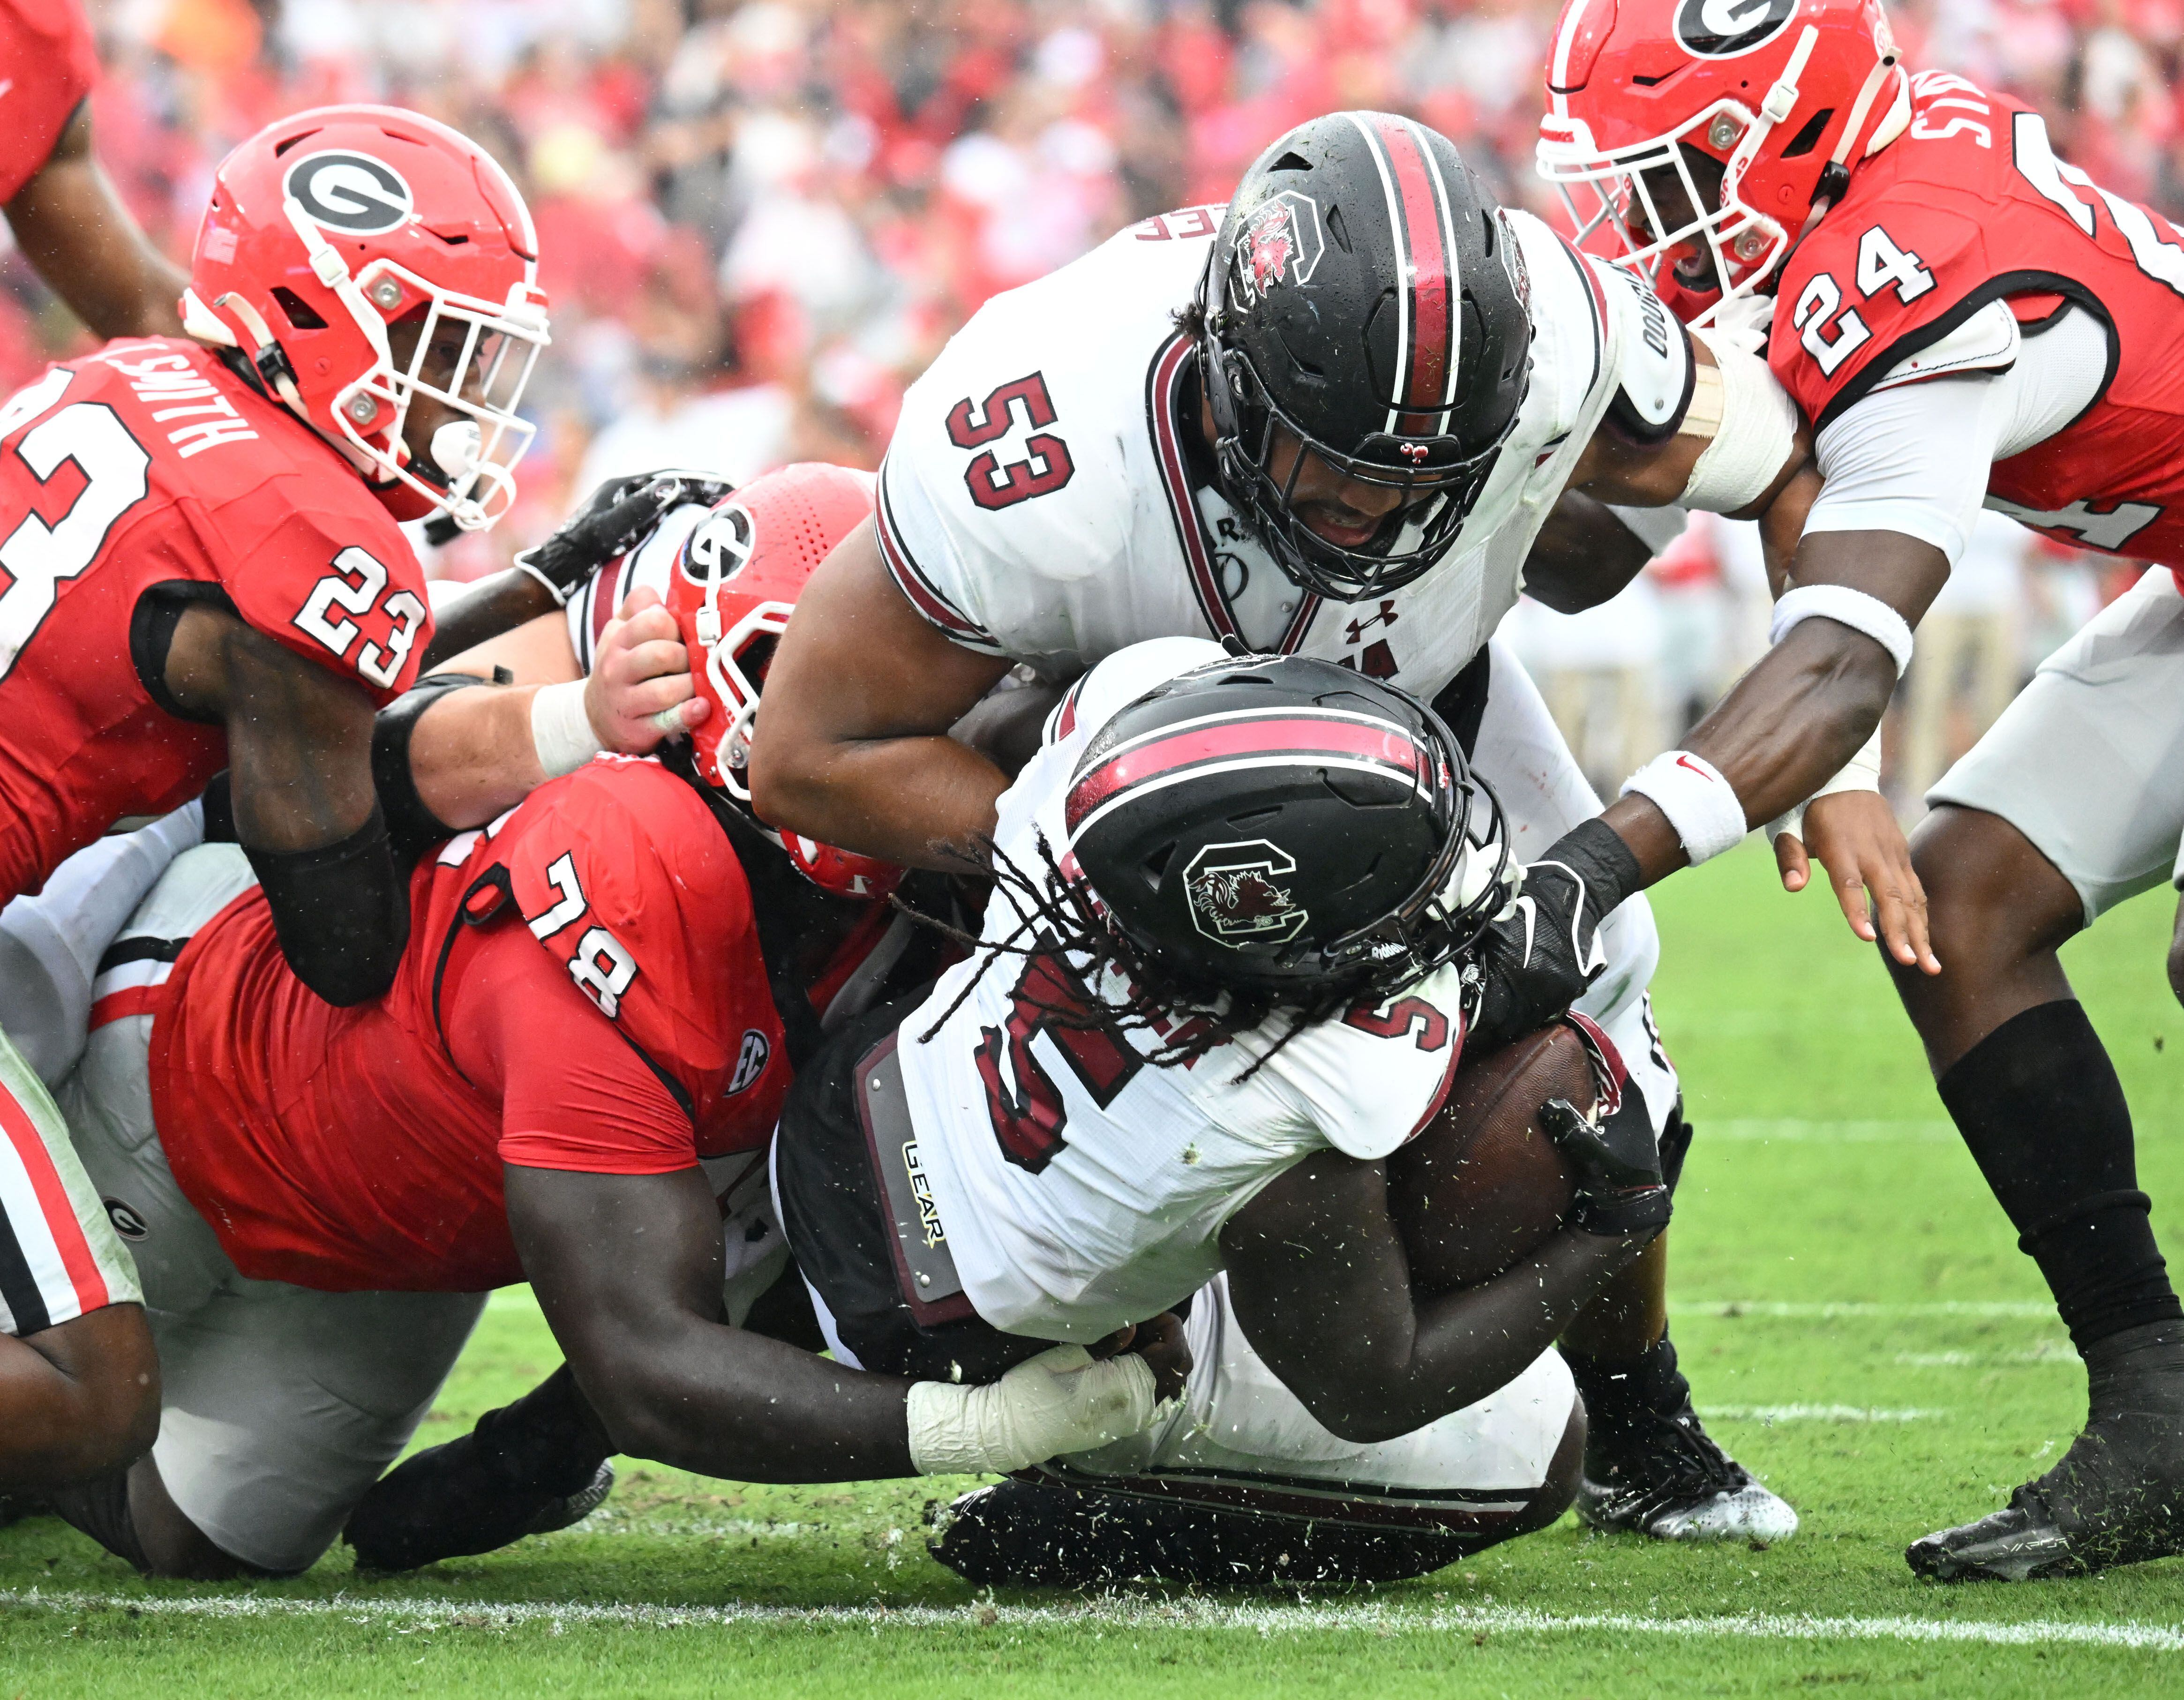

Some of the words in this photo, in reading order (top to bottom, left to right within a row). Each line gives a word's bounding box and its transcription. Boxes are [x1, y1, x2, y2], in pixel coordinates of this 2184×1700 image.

[288, 154, 407, 230] G
[1125, 206, 1227, 241] EE
[1793, 224, 1939, 379] 24
[104, 354, 259, 458] SMITH
[945, 370, 1075, 511] 53
[292, 545, 427, 689] 23
[527, 849, 639, 1022] 78
[1372, 942, 1407, 959] Riddell
[728, 1035, 766, 1093] EC
[904, 1143, 945, 1240] GEAR
